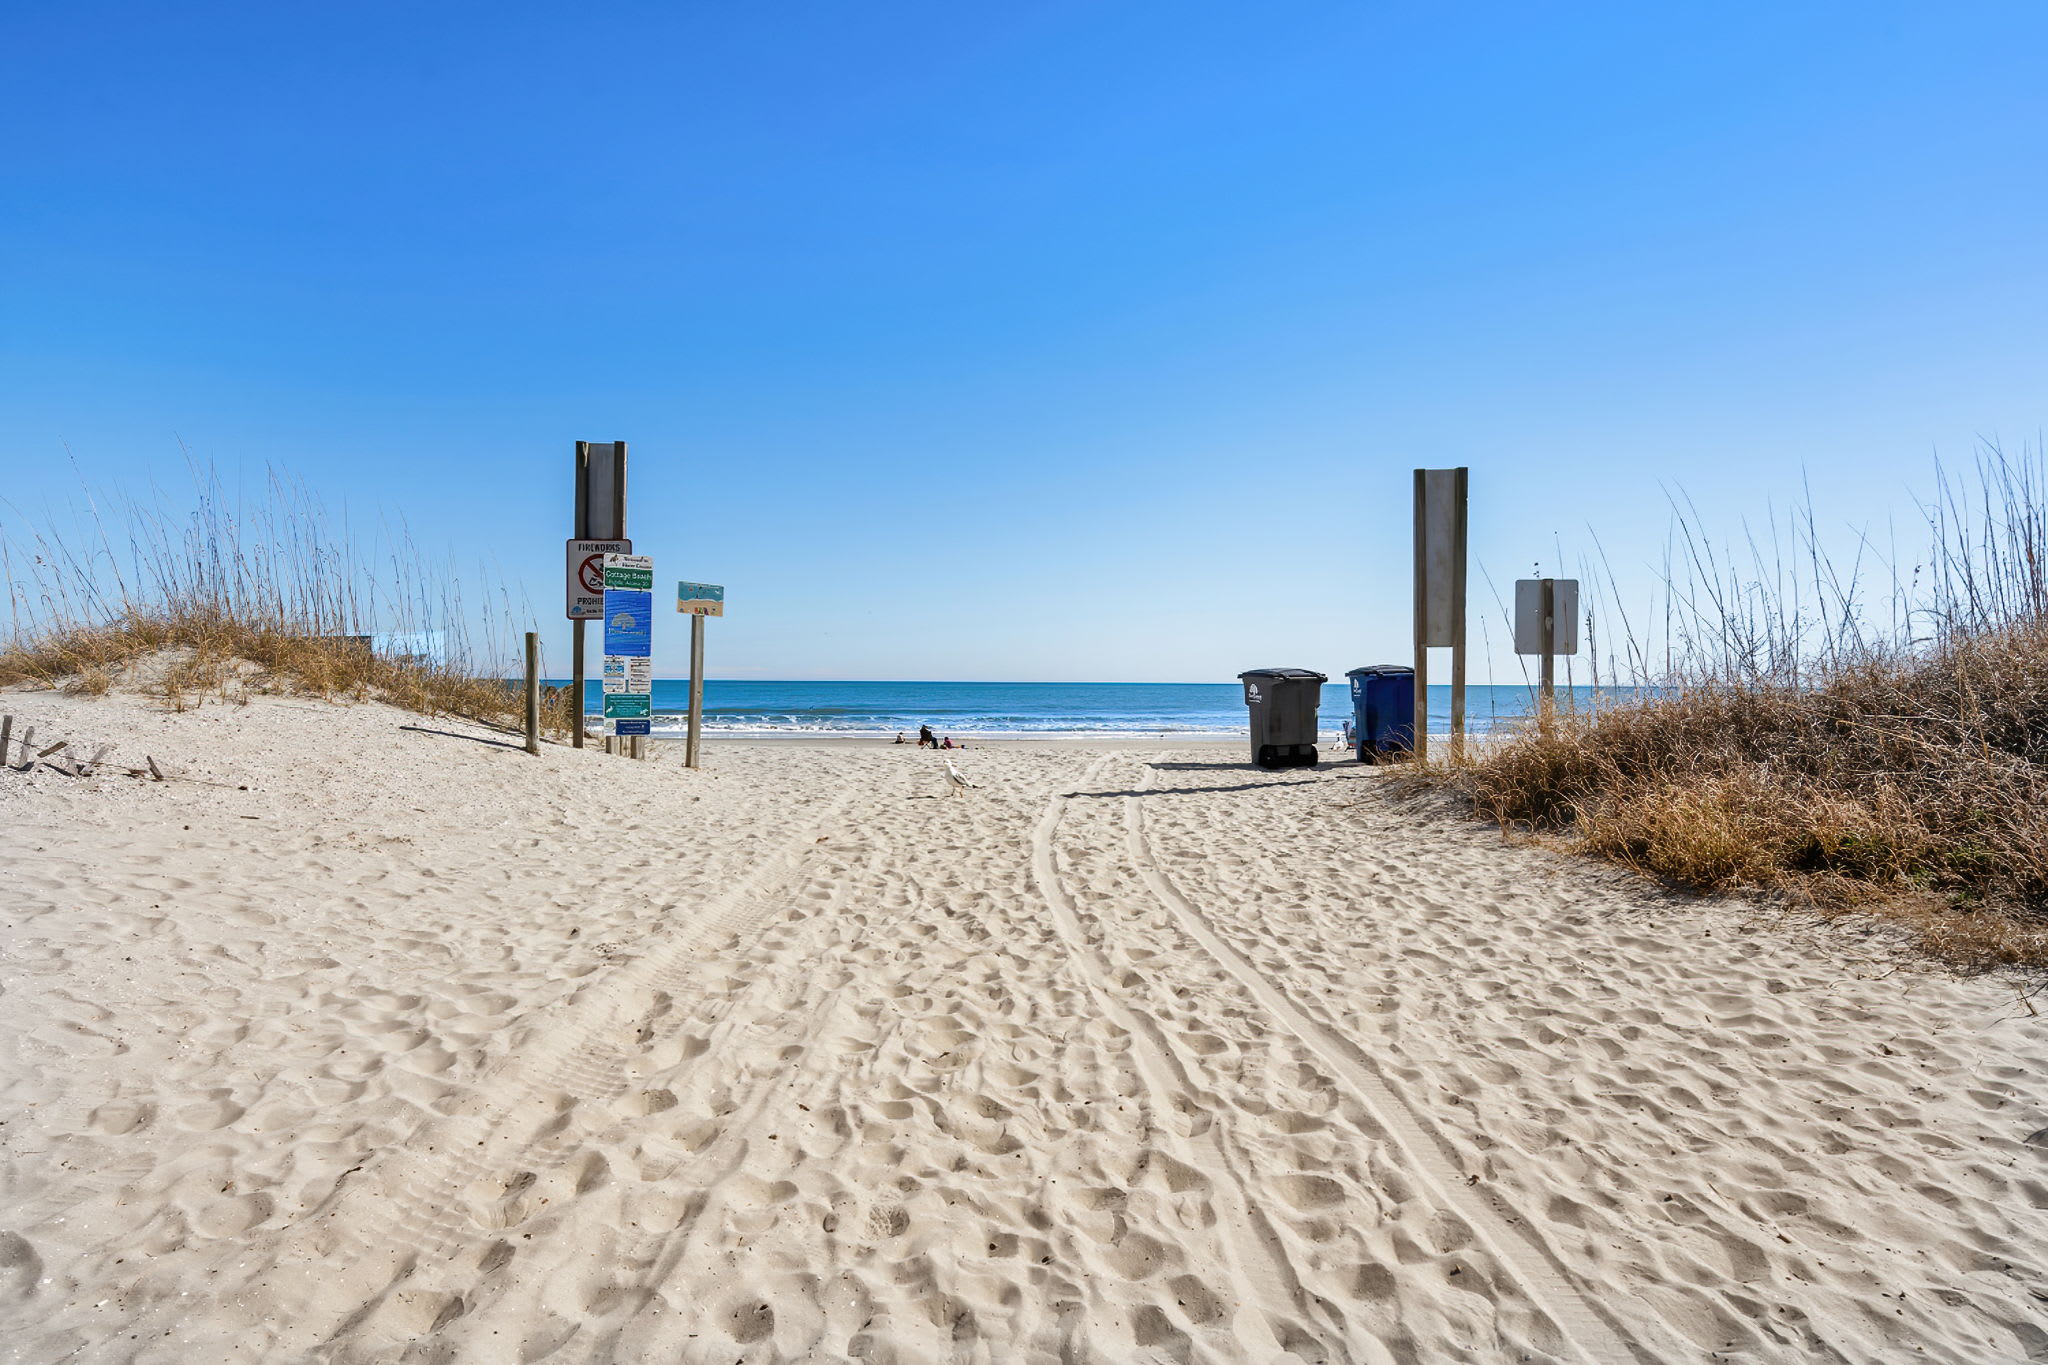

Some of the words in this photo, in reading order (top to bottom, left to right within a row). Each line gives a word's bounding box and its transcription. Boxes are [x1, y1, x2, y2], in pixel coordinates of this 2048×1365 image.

[578, 543, 621, 552] FIREWORKS
[606, 570, 631, 580] Cottage
[577, 597, 604, 605] PROHIB
